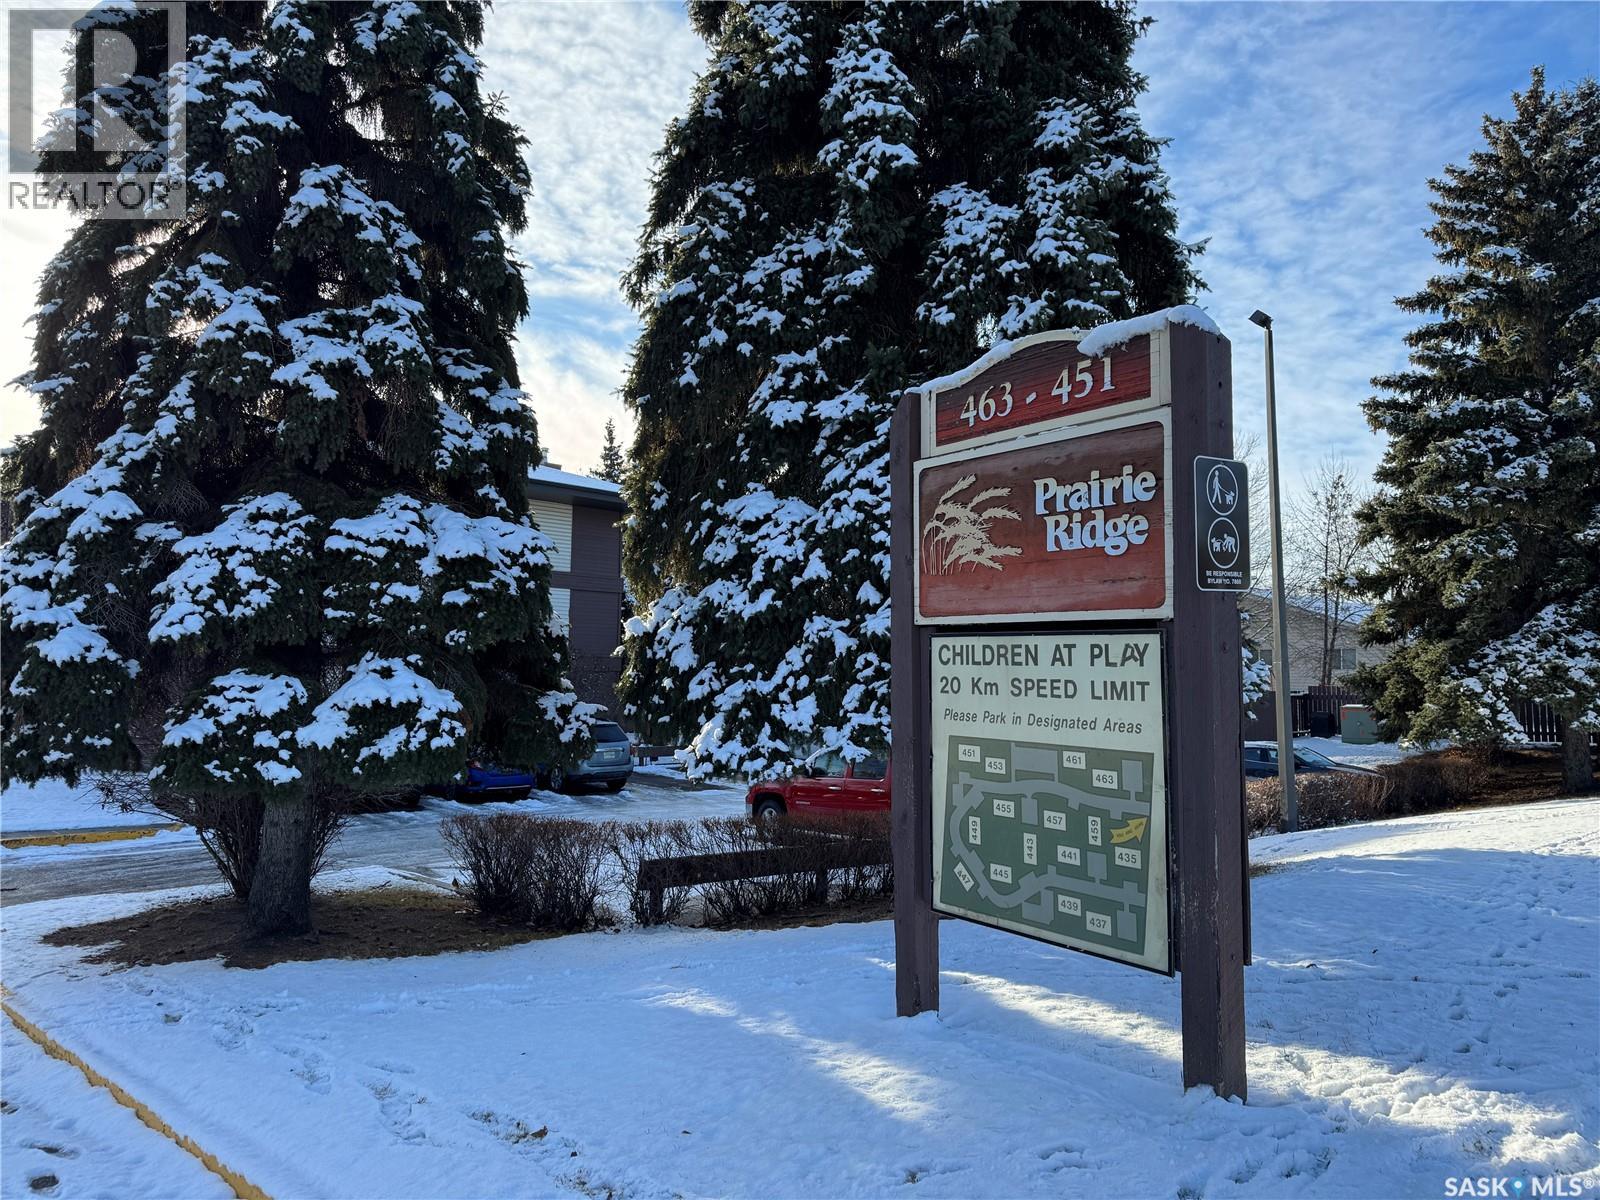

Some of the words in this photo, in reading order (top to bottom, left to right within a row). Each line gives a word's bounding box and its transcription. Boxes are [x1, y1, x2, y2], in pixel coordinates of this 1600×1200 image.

[960, 381, 1014, 427] 463
[1051, 356, 1116, 404] 451
[1033, 464, 1157, 515] Prairie
[1043, 509, 1149, 556] Ridge
[938, 644, 1039, 666] CHILDREN
[1050, 643, 1077, 667] AT
[1090, 643, 1150, 667] PLAY
[940, 676, 961, 694] 20
[971, 677, 999, 696] Km
[1010, 677, 1078, 699] SPEED
[1090, 680, 1150, 702] LIMIT
[944, 708, 978, 722] Please
[983, 710, 1006, 724] Park
[1012, 712, 1022, 725] in
[1027, 713, 1097, 731] Designated
[1103, 717, 1143, 734] Areas
[962, 748, 976, 758] 451
[987, 761, 1003, 770] 453
[1065, 755, 1082, 765] 461
[1095, 774, 1114, 784] 463
[995, 803, 1012, 813] 455
[1046, 815, 1063, 825] 457
[1090, 819, 1099, 842] 459
[1026, 838, 1034, 860] 443
[1061, 850, 1077, 861] 441
[1117, 852, 1137, 863] 435
[957, 870, 971, 885] 447
[992, 868, 1009, 879] 445
[1060, 899, 1078, 911] 439
[1089, 917, 1107, 929] 437
